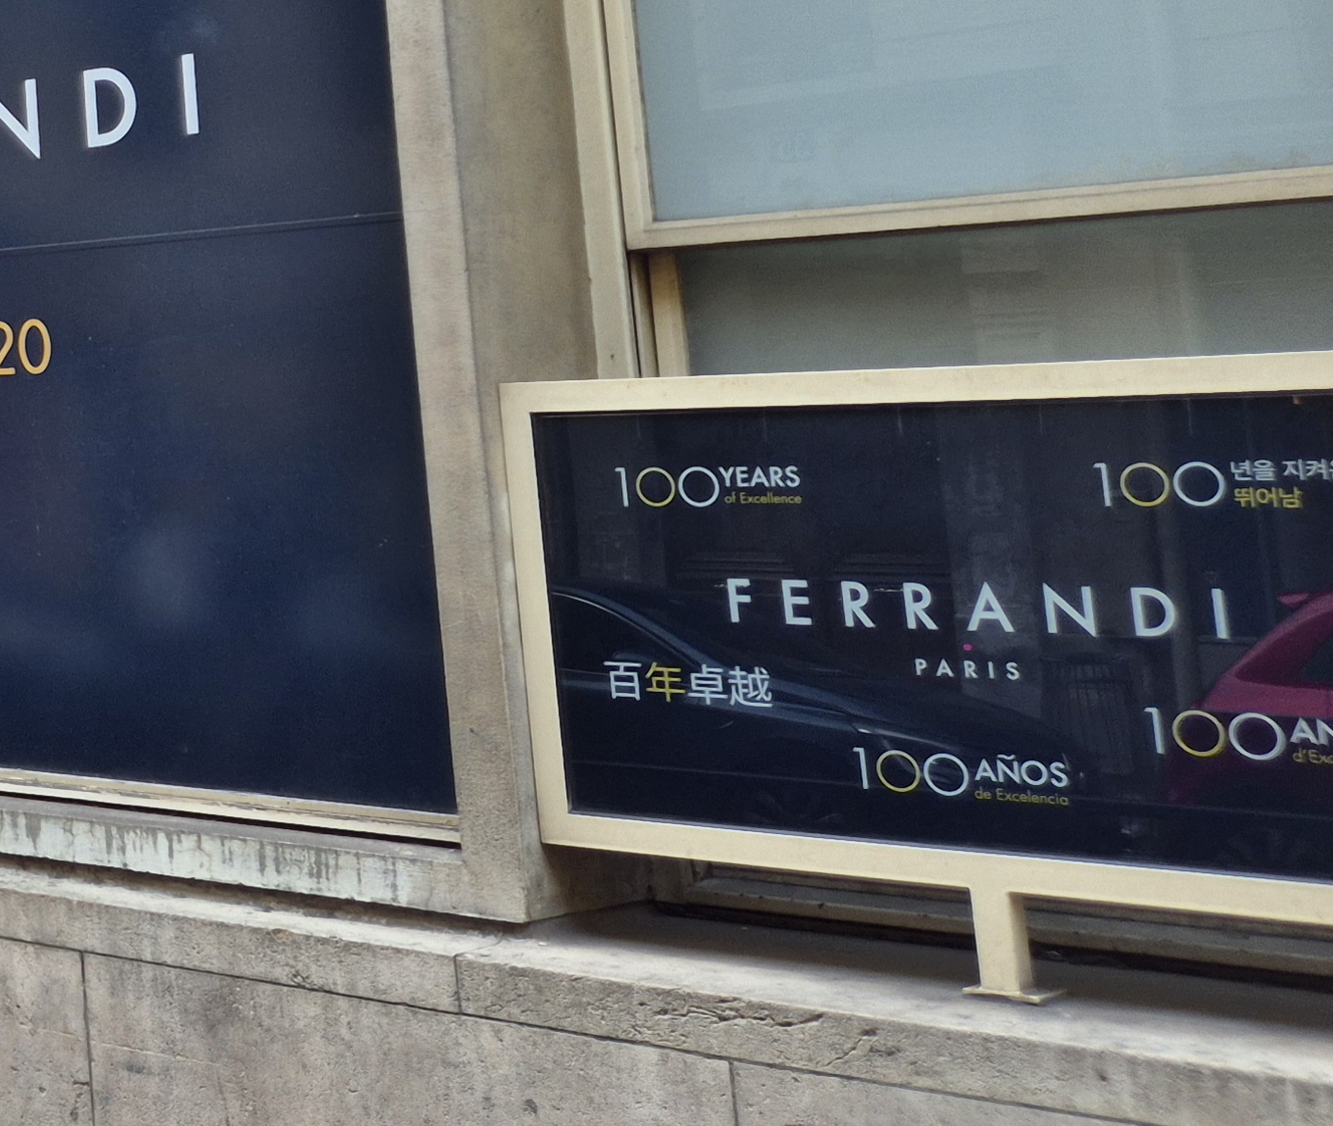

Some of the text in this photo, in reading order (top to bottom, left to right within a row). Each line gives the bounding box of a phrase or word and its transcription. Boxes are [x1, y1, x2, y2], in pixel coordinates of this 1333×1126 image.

[1230, 459, 1277, 482] 년을
[1283, 458, 1333, 481] 지켜
[724, 491, 803, 505] of Excellence
[726, 577, 1232, 640] FERRANDI
[914, 657, 1021, 681] PARIS
[603, 661, 773, 708] 百年卓越
[1289, 716, 1333, 746] AN
[974, 754, 1071, 788] AÑOS
[974, 787, 1070, 806] de Excelencia
